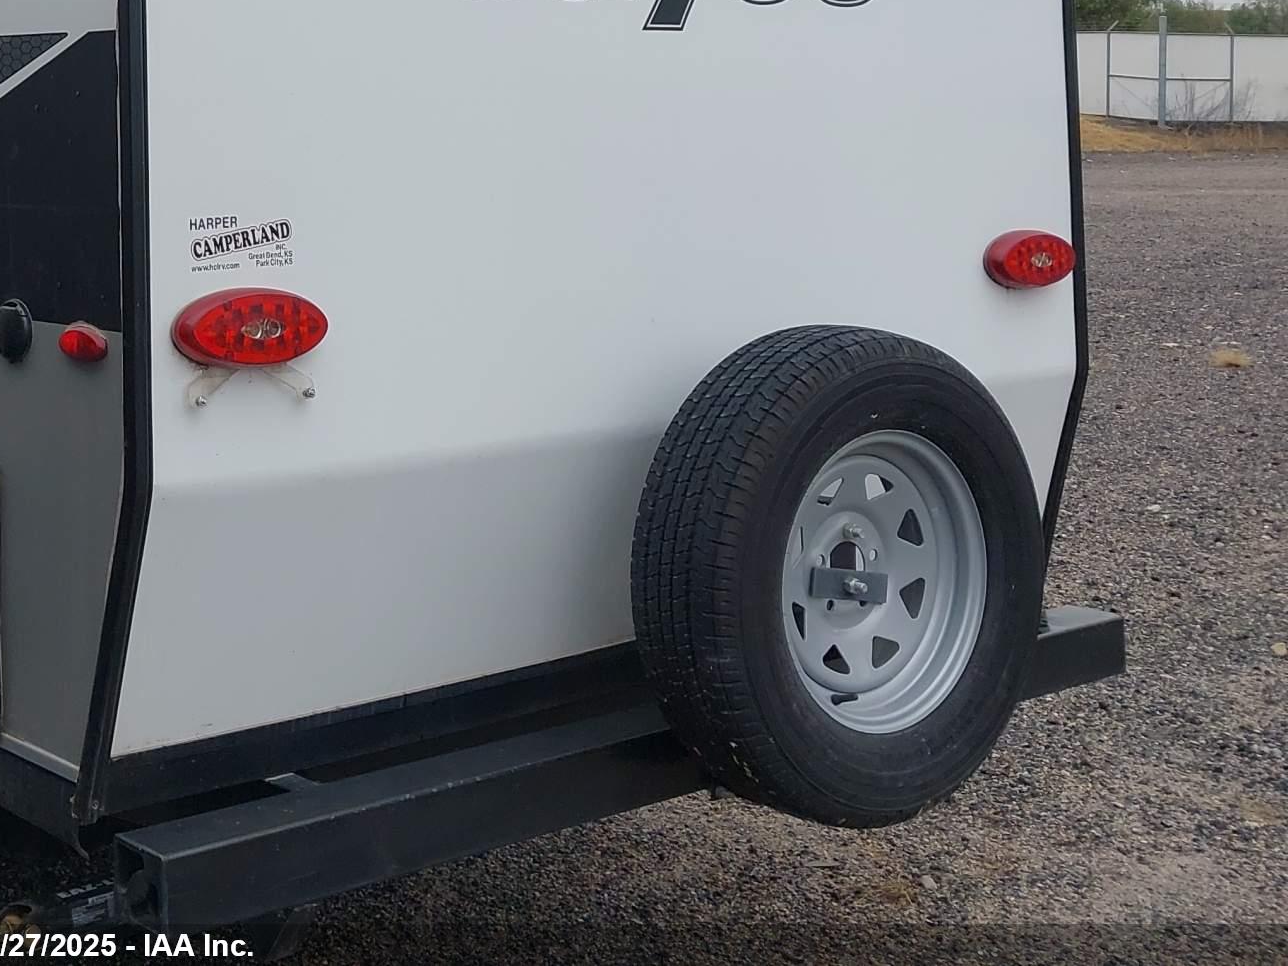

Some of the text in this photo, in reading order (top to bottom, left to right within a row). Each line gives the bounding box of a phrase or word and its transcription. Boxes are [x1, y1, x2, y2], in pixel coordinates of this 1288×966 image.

[189, 216, 238, 231] HARPER
[192, 220, 291, 260] CAMPERLAND
[248, 252, 265, 260] Great
[256, 259, 269, 267] Park
